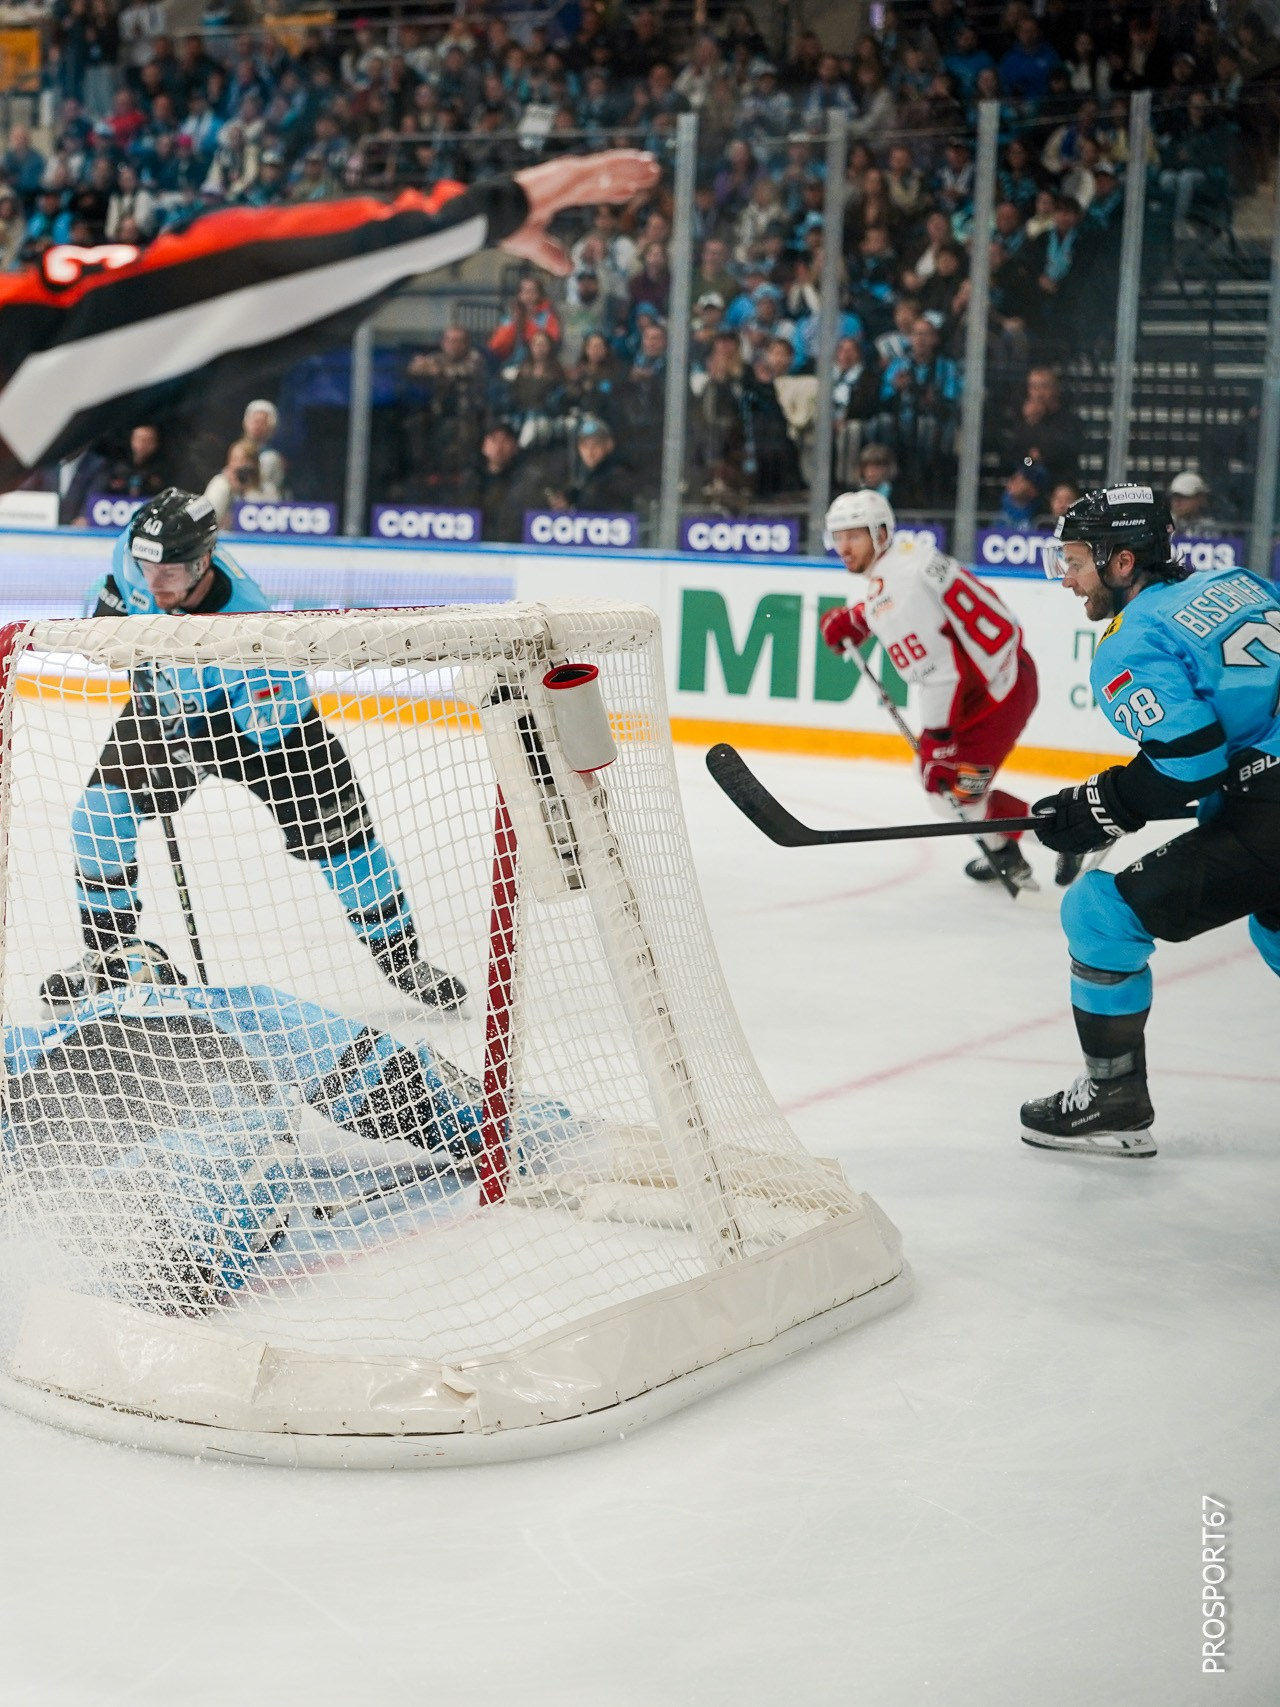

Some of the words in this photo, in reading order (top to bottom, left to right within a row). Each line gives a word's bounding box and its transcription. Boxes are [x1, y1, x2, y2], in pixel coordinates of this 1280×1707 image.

[1108, 486, 1154, 502] Belavia
[888, 633, 927, 669] 86
[1114, 687, 1166, 742] 28
